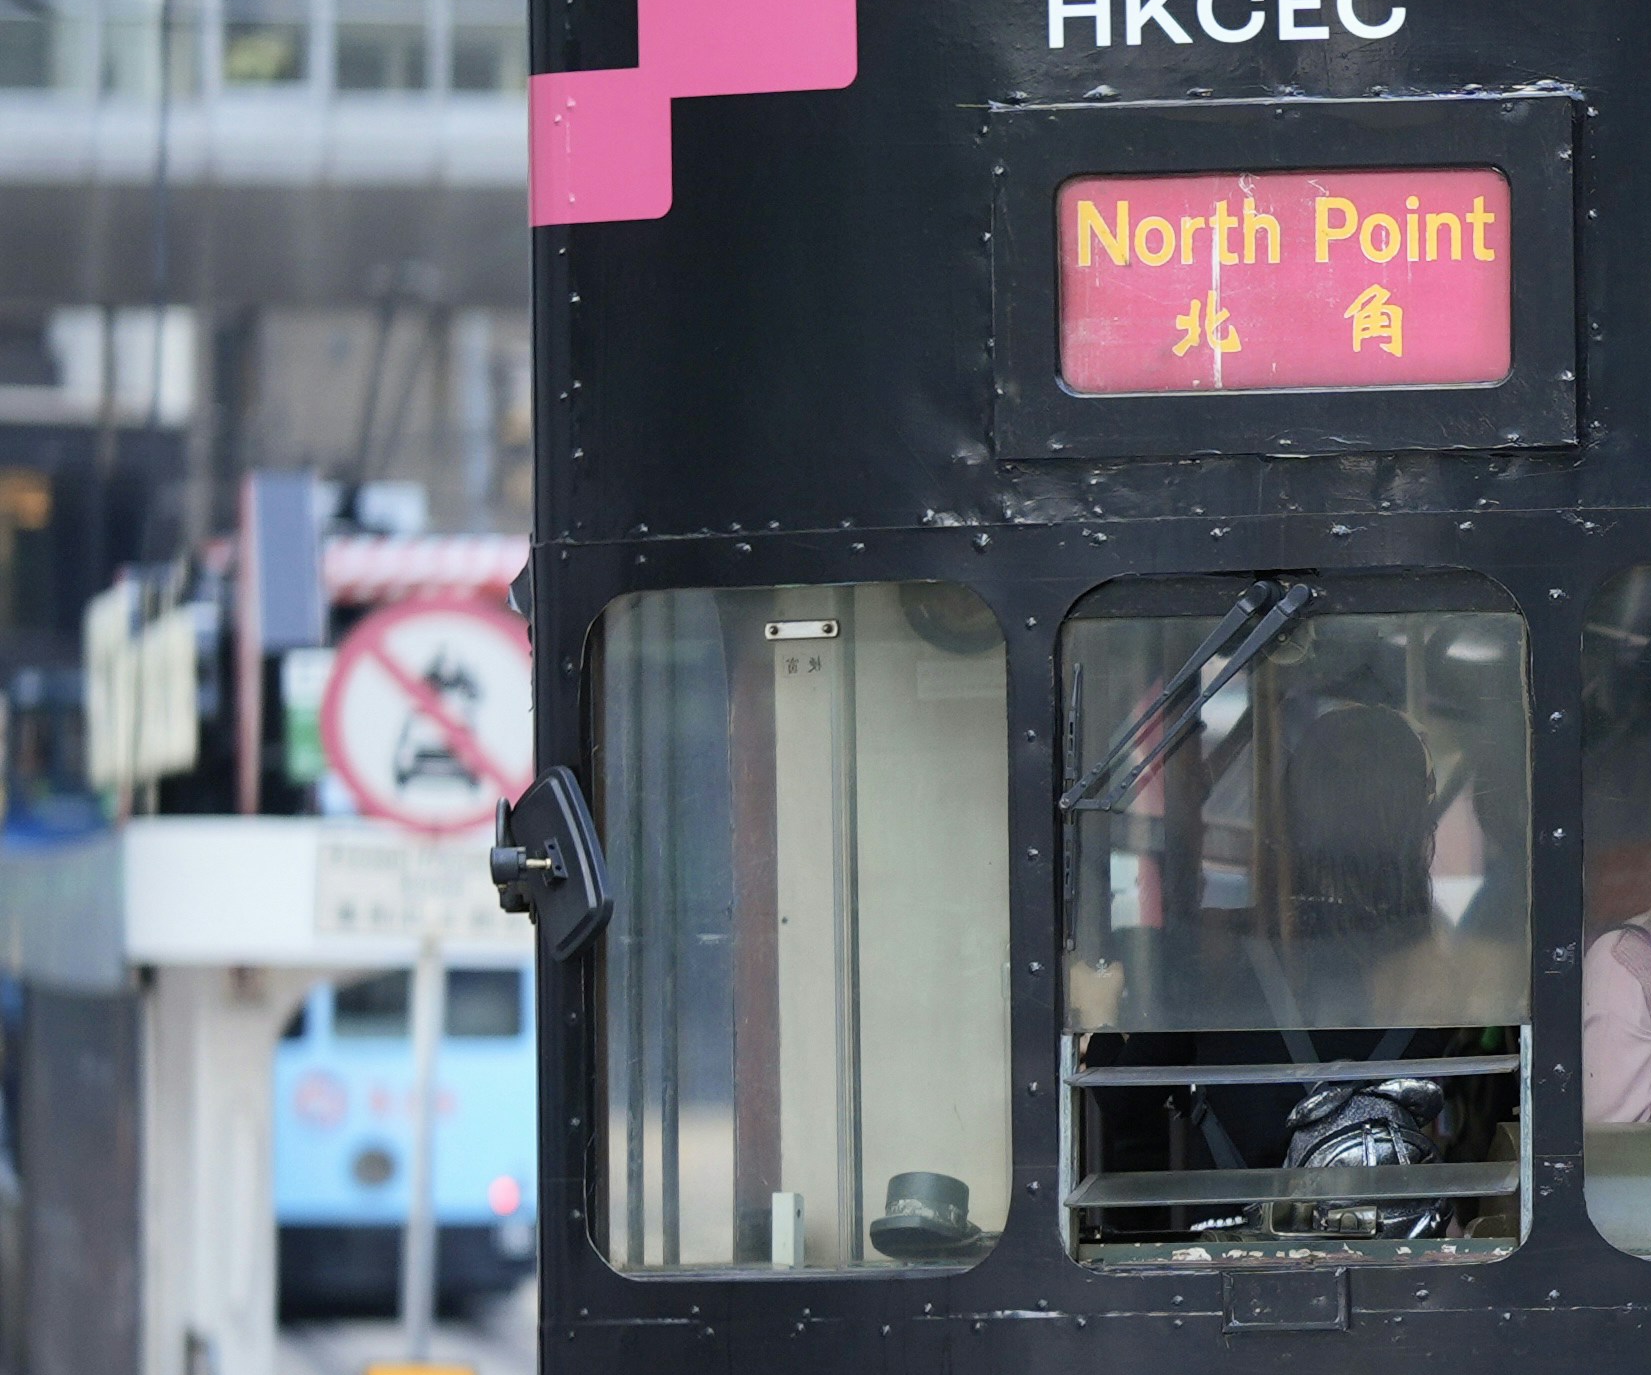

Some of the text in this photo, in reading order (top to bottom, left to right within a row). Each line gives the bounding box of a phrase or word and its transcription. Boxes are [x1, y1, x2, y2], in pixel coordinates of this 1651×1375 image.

[1076, 195, 1495, 267] North Point
[1171, 283, 1404, 358] 北角
